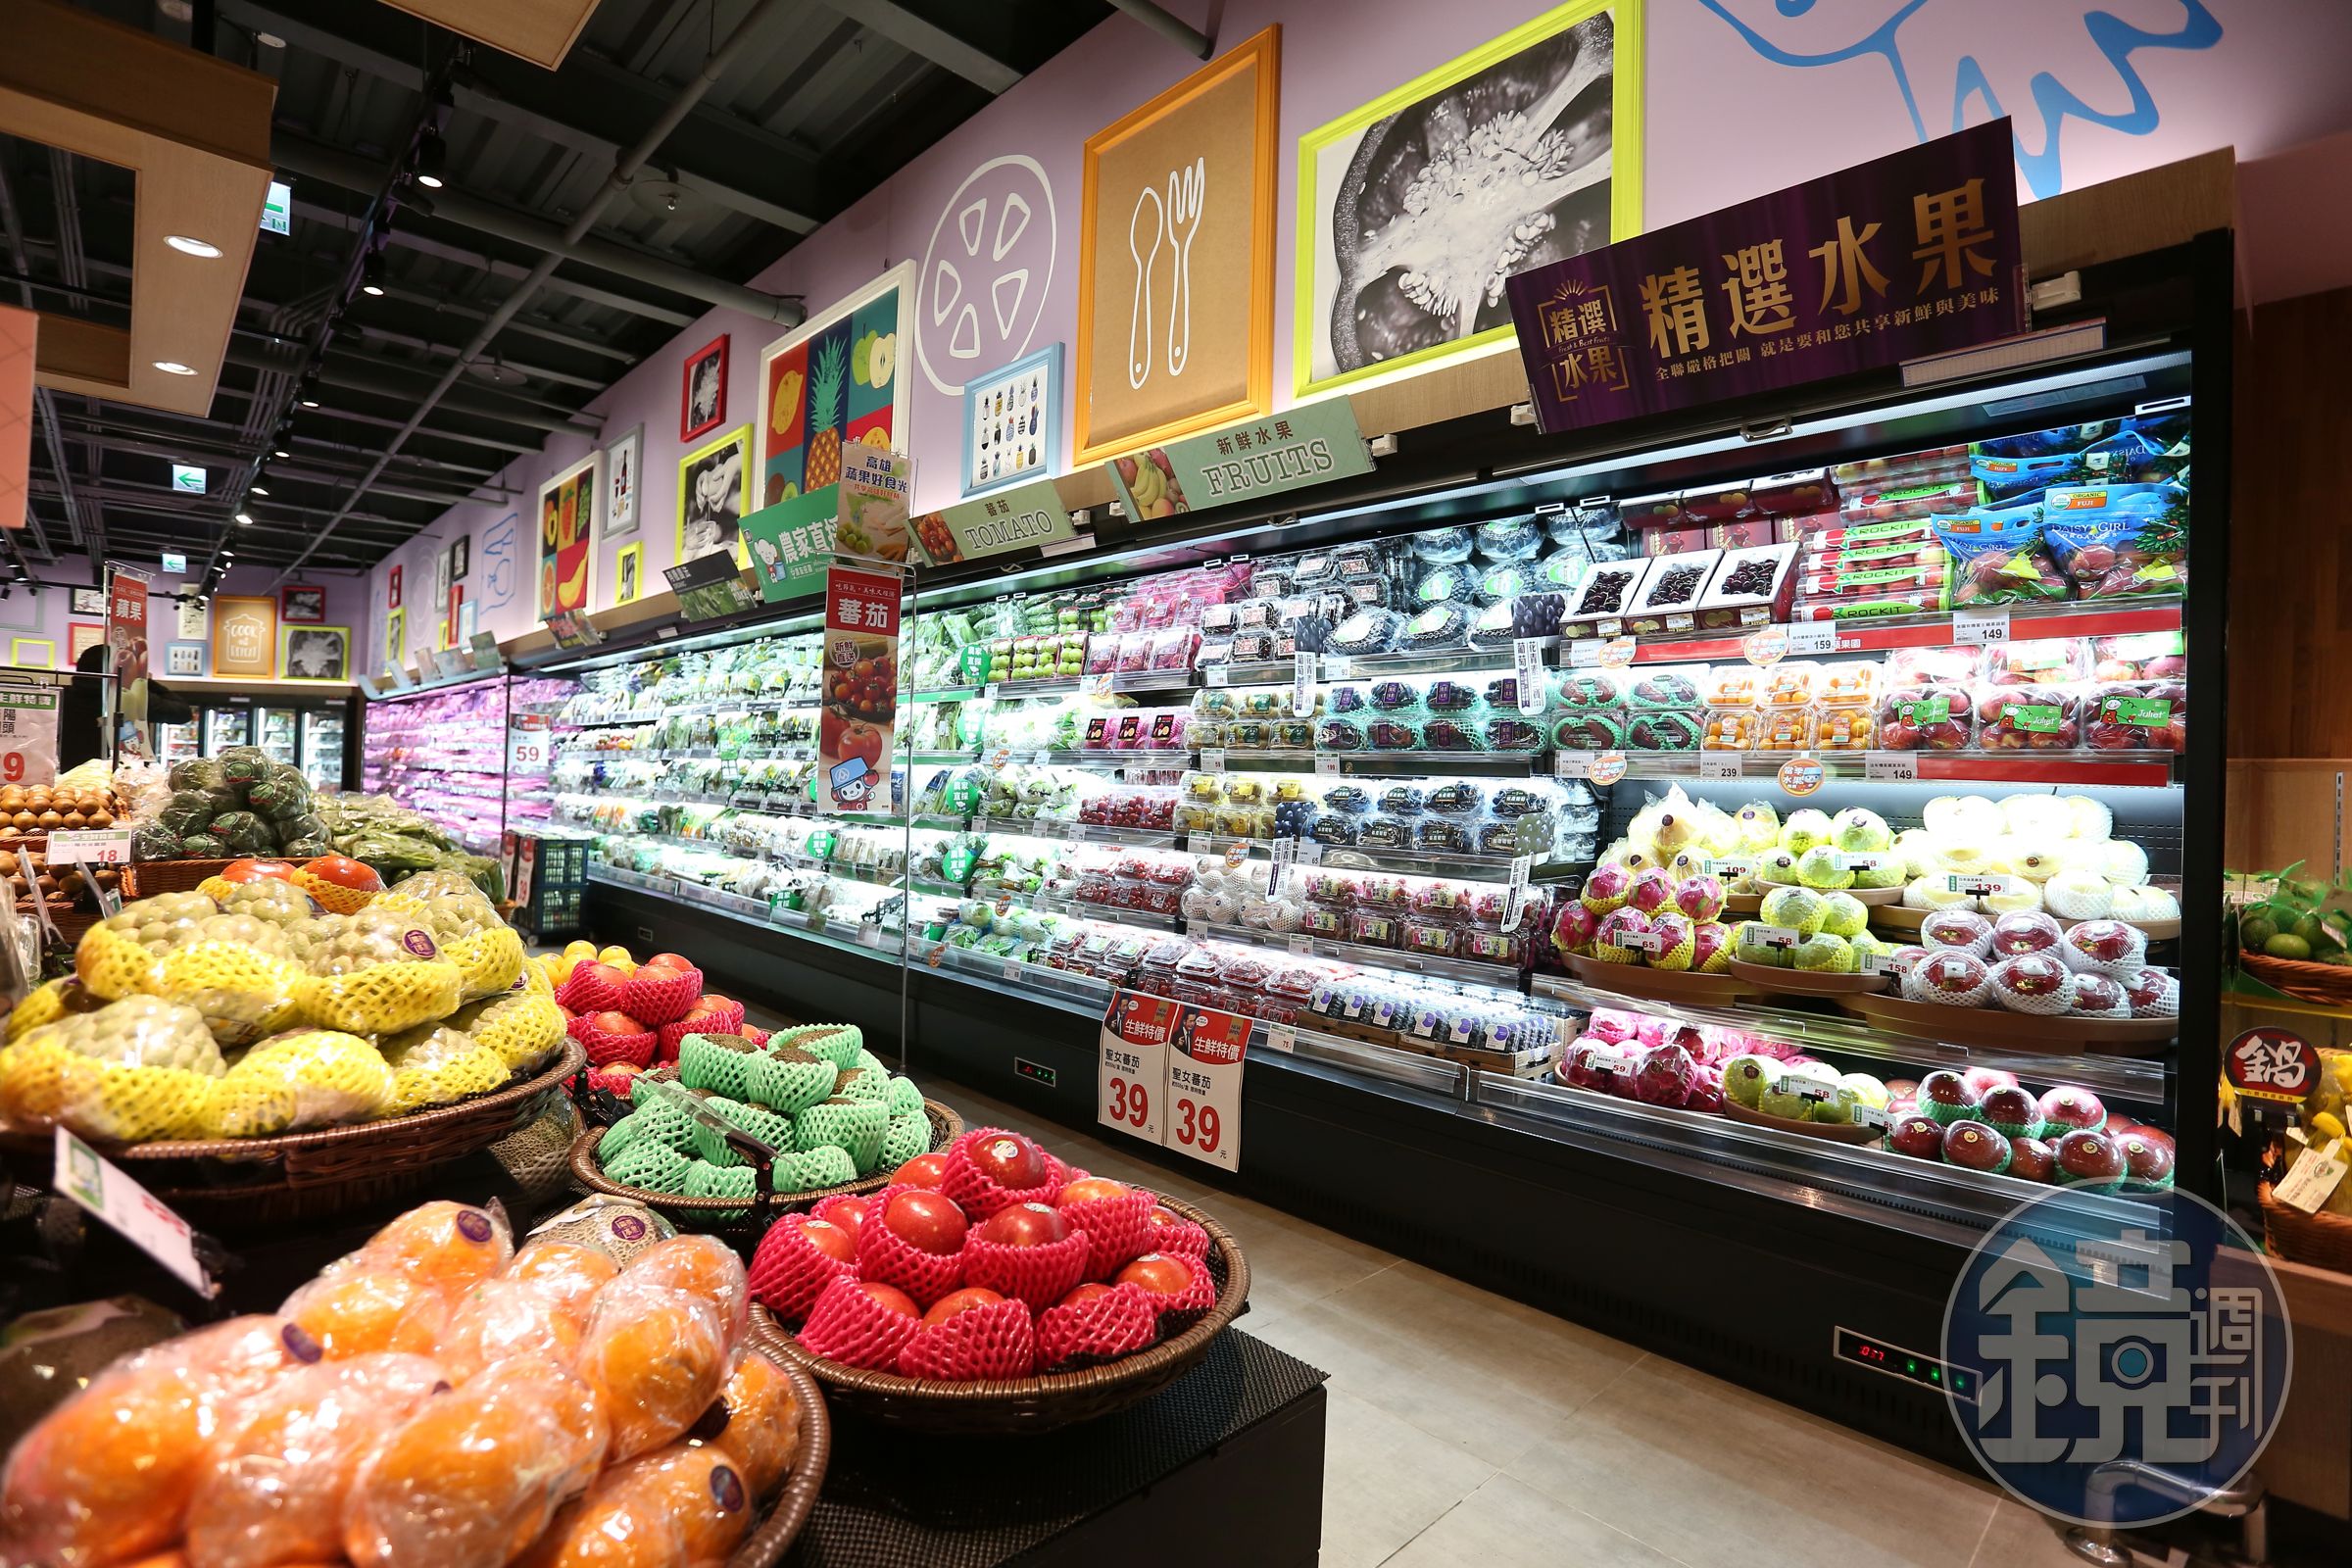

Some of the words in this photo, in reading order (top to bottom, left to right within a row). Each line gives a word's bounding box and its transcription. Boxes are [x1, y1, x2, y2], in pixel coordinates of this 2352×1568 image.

[1639, 178, 1997, 359] 精選水果
[1549, 299, 1607, 344] 精選
[1654, 348, 1751, 381] 全聯嚴格把關
[1760, 288, 1999, 358] 就是要和您共享新鮮與美味
[1559, 345, 1618, 389] 水果
[1216, 419, 1294, 456] 新鮮水果
[866, 455, 892, 473] 高雄
[1201, 439, 1334, 496] FRUITS
[845, 466, 907, 493] 蔬果好食光
[964, 511, 1054, 550] TOMATO
[1859, 522, 1914, 534] ROCKIT
[2052, 524, 2089, 533] DAISY
[2098, 521, 2131, 532] GIRL
[1855, 545, 1908, 556] ROCKIT
[1852, 569, 1908, 580] ROCKIT
[1847, 606, 1903, 618] ROCKIT
[1982, 628, 2002, 640] 149
[1814, 640, 1832, 650] 159
[2137, 709, 2166, 718] Juliet
[2033, 715, 2057, 725] Juliet
[516, 746, 539, 762] 59
[0, 752, 24, 782] 9
[1721, 767, 1737, 777] 239
[1893, 769, 1912, 780] 149
[97, 850, 118, 862] 18
[1976, 883, 2001, 892] 139
[1778, 937, 1792, 946] 58
[1887, 963, 1907, 973] 158
[1124, 1019, 1166, 1042] 生鮮特價
[1194, 1036, 1241, 1061] 生鮮特價
[2235, 1035, 2306, 1089] 鍋
[1814, 1089, 1830, 1099] 58
[1109, 1077, 1149, 1128] 39
[1148, 1124, 1154, 1134] 元
[1176, 1098, 1220, 1153] 39
[1220, 1150, 1227, 1159] 元
